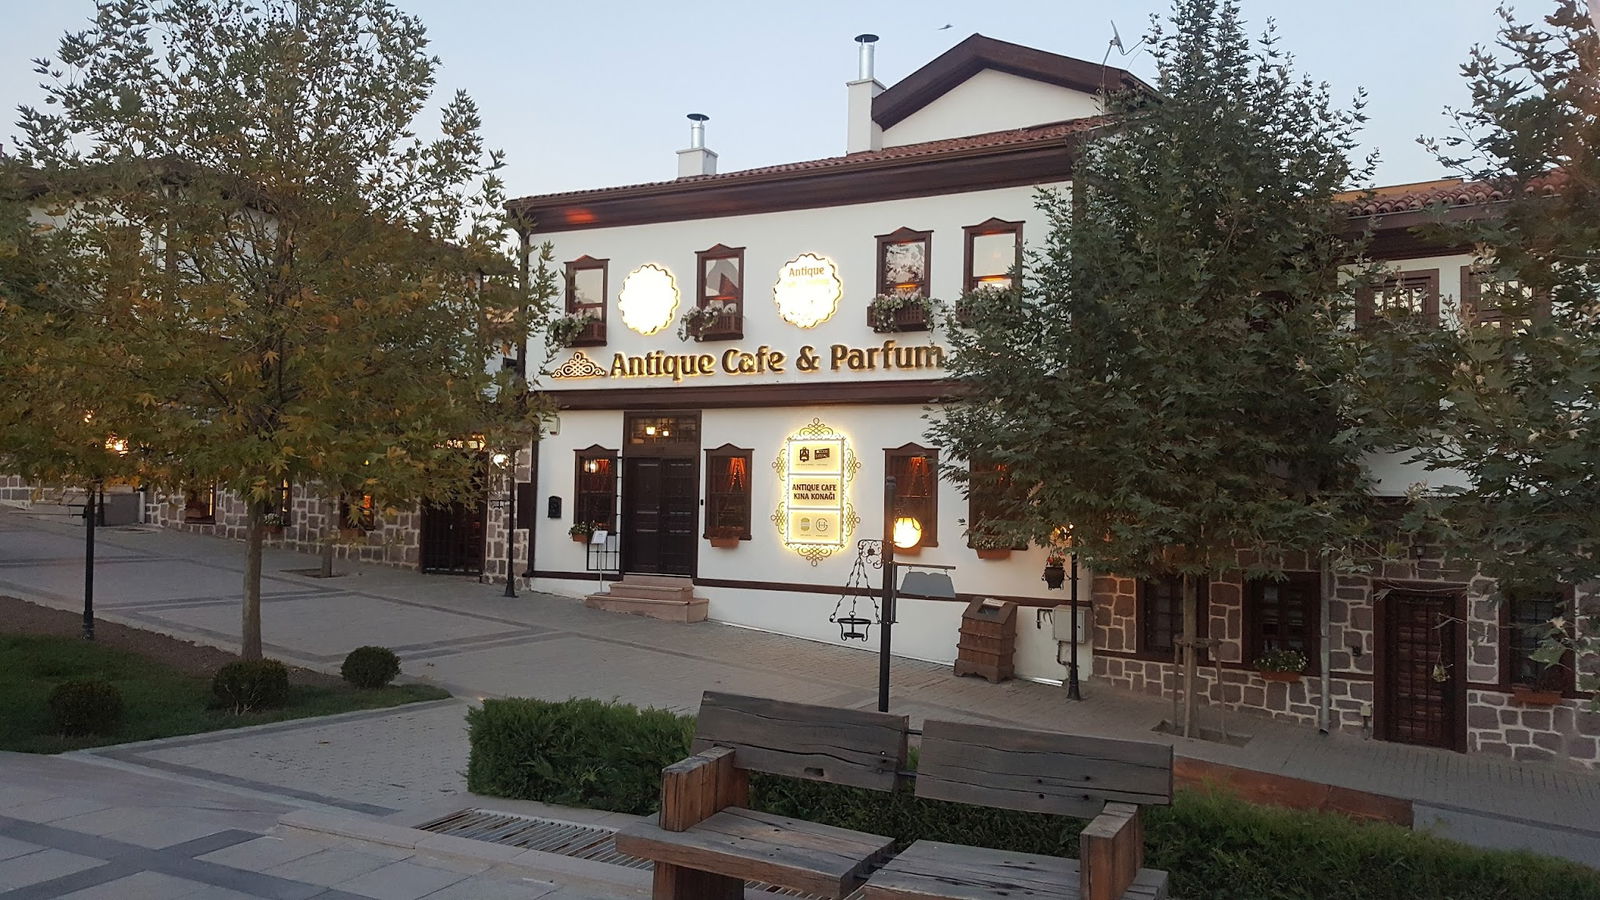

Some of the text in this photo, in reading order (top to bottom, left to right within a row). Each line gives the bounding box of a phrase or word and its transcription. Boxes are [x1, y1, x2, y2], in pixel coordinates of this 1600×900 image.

[789, 266, 825, 278] Antique
[609, 338, 944, 382] Antique Cafe & Parfum
[792, 483, 819, 491] ANTIQUE
